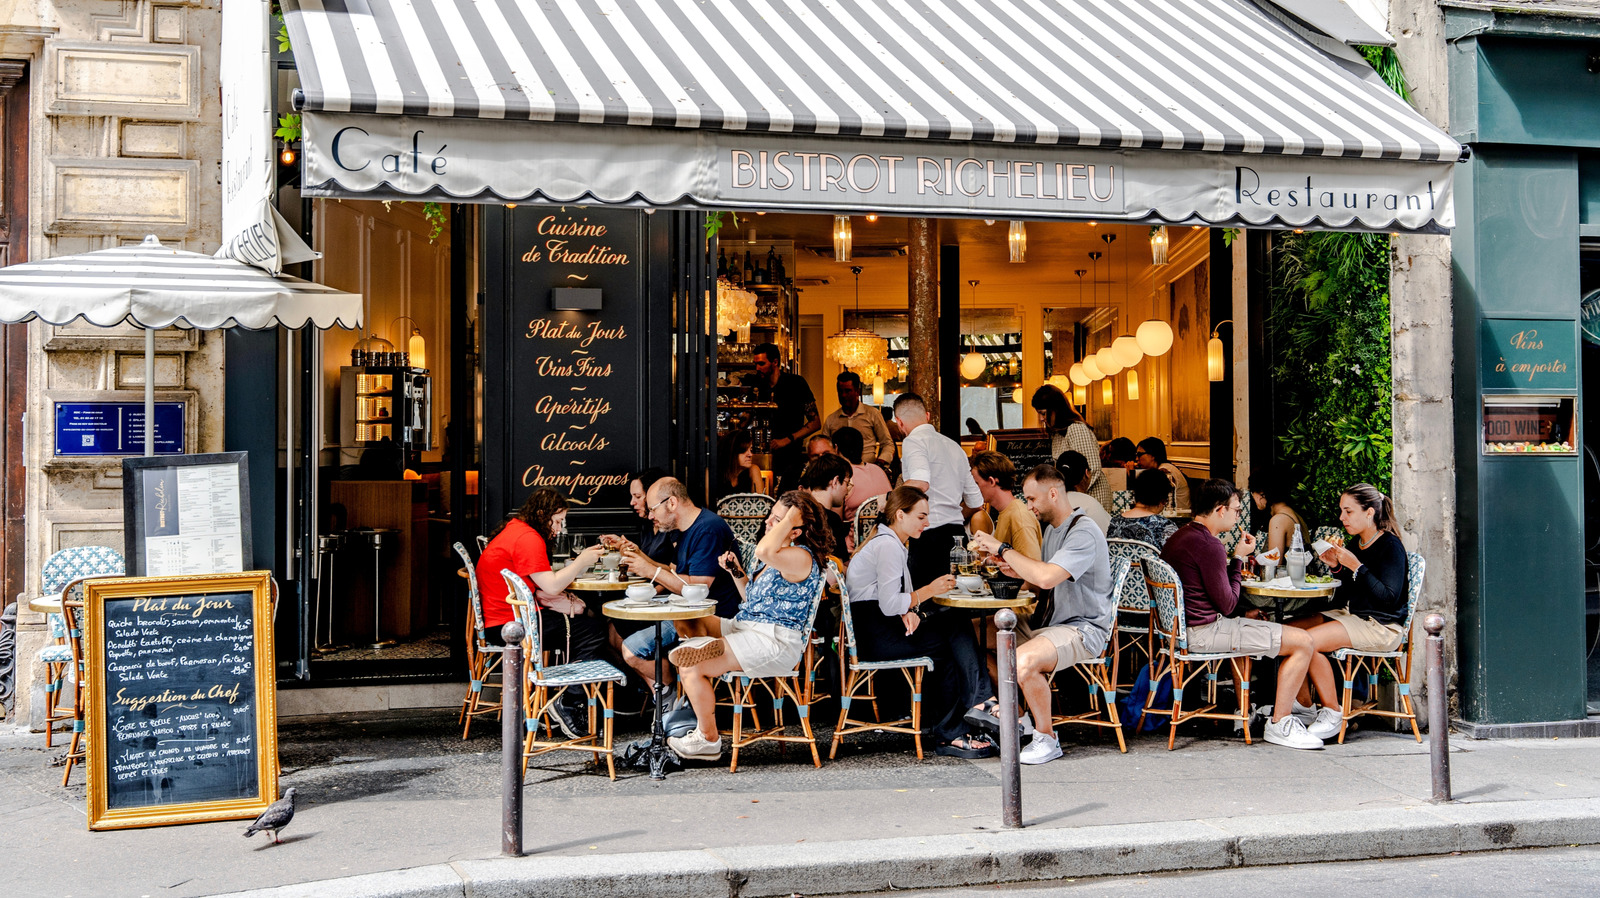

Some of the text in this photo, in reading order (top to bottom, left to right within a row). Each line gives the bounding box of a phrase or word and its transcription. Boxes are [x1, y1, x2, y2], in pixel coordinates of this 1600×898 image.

[331, 126, 447, 176] Café
[730, 149, 1115, 203] BISTROT RICHELIEU
[1235, 166, 1436, 211] Restaurant
[537, 215, 608, 237] Cuisine
[522, 239, 630, 266] de Tradition
[525, 318, 627, 348] Plat du Jour
[1510, 329, 1544, 350] Vins
[535, 355, 614, 378] Vins Fins
[1495, 356, 1567, 382] à emporter
[535, 395, 612, 425] Apéritifs
[1484, 420, 1546, 436] OOD WINE
[540, 432, 610, 452] Alcools
[521, 464, 630, 496] Champagnes
[132, 595, 235, 618] Plat du Jour
[108, 617, 133, 628] Quiche
[115, 628, 139, 638] Salade
[203, 634, 213, 642] de
[146, 659, 156, 668] de
[119, 671, 144, 682] Salade
[112, 682, 240, 712] Suggestion du Chef
